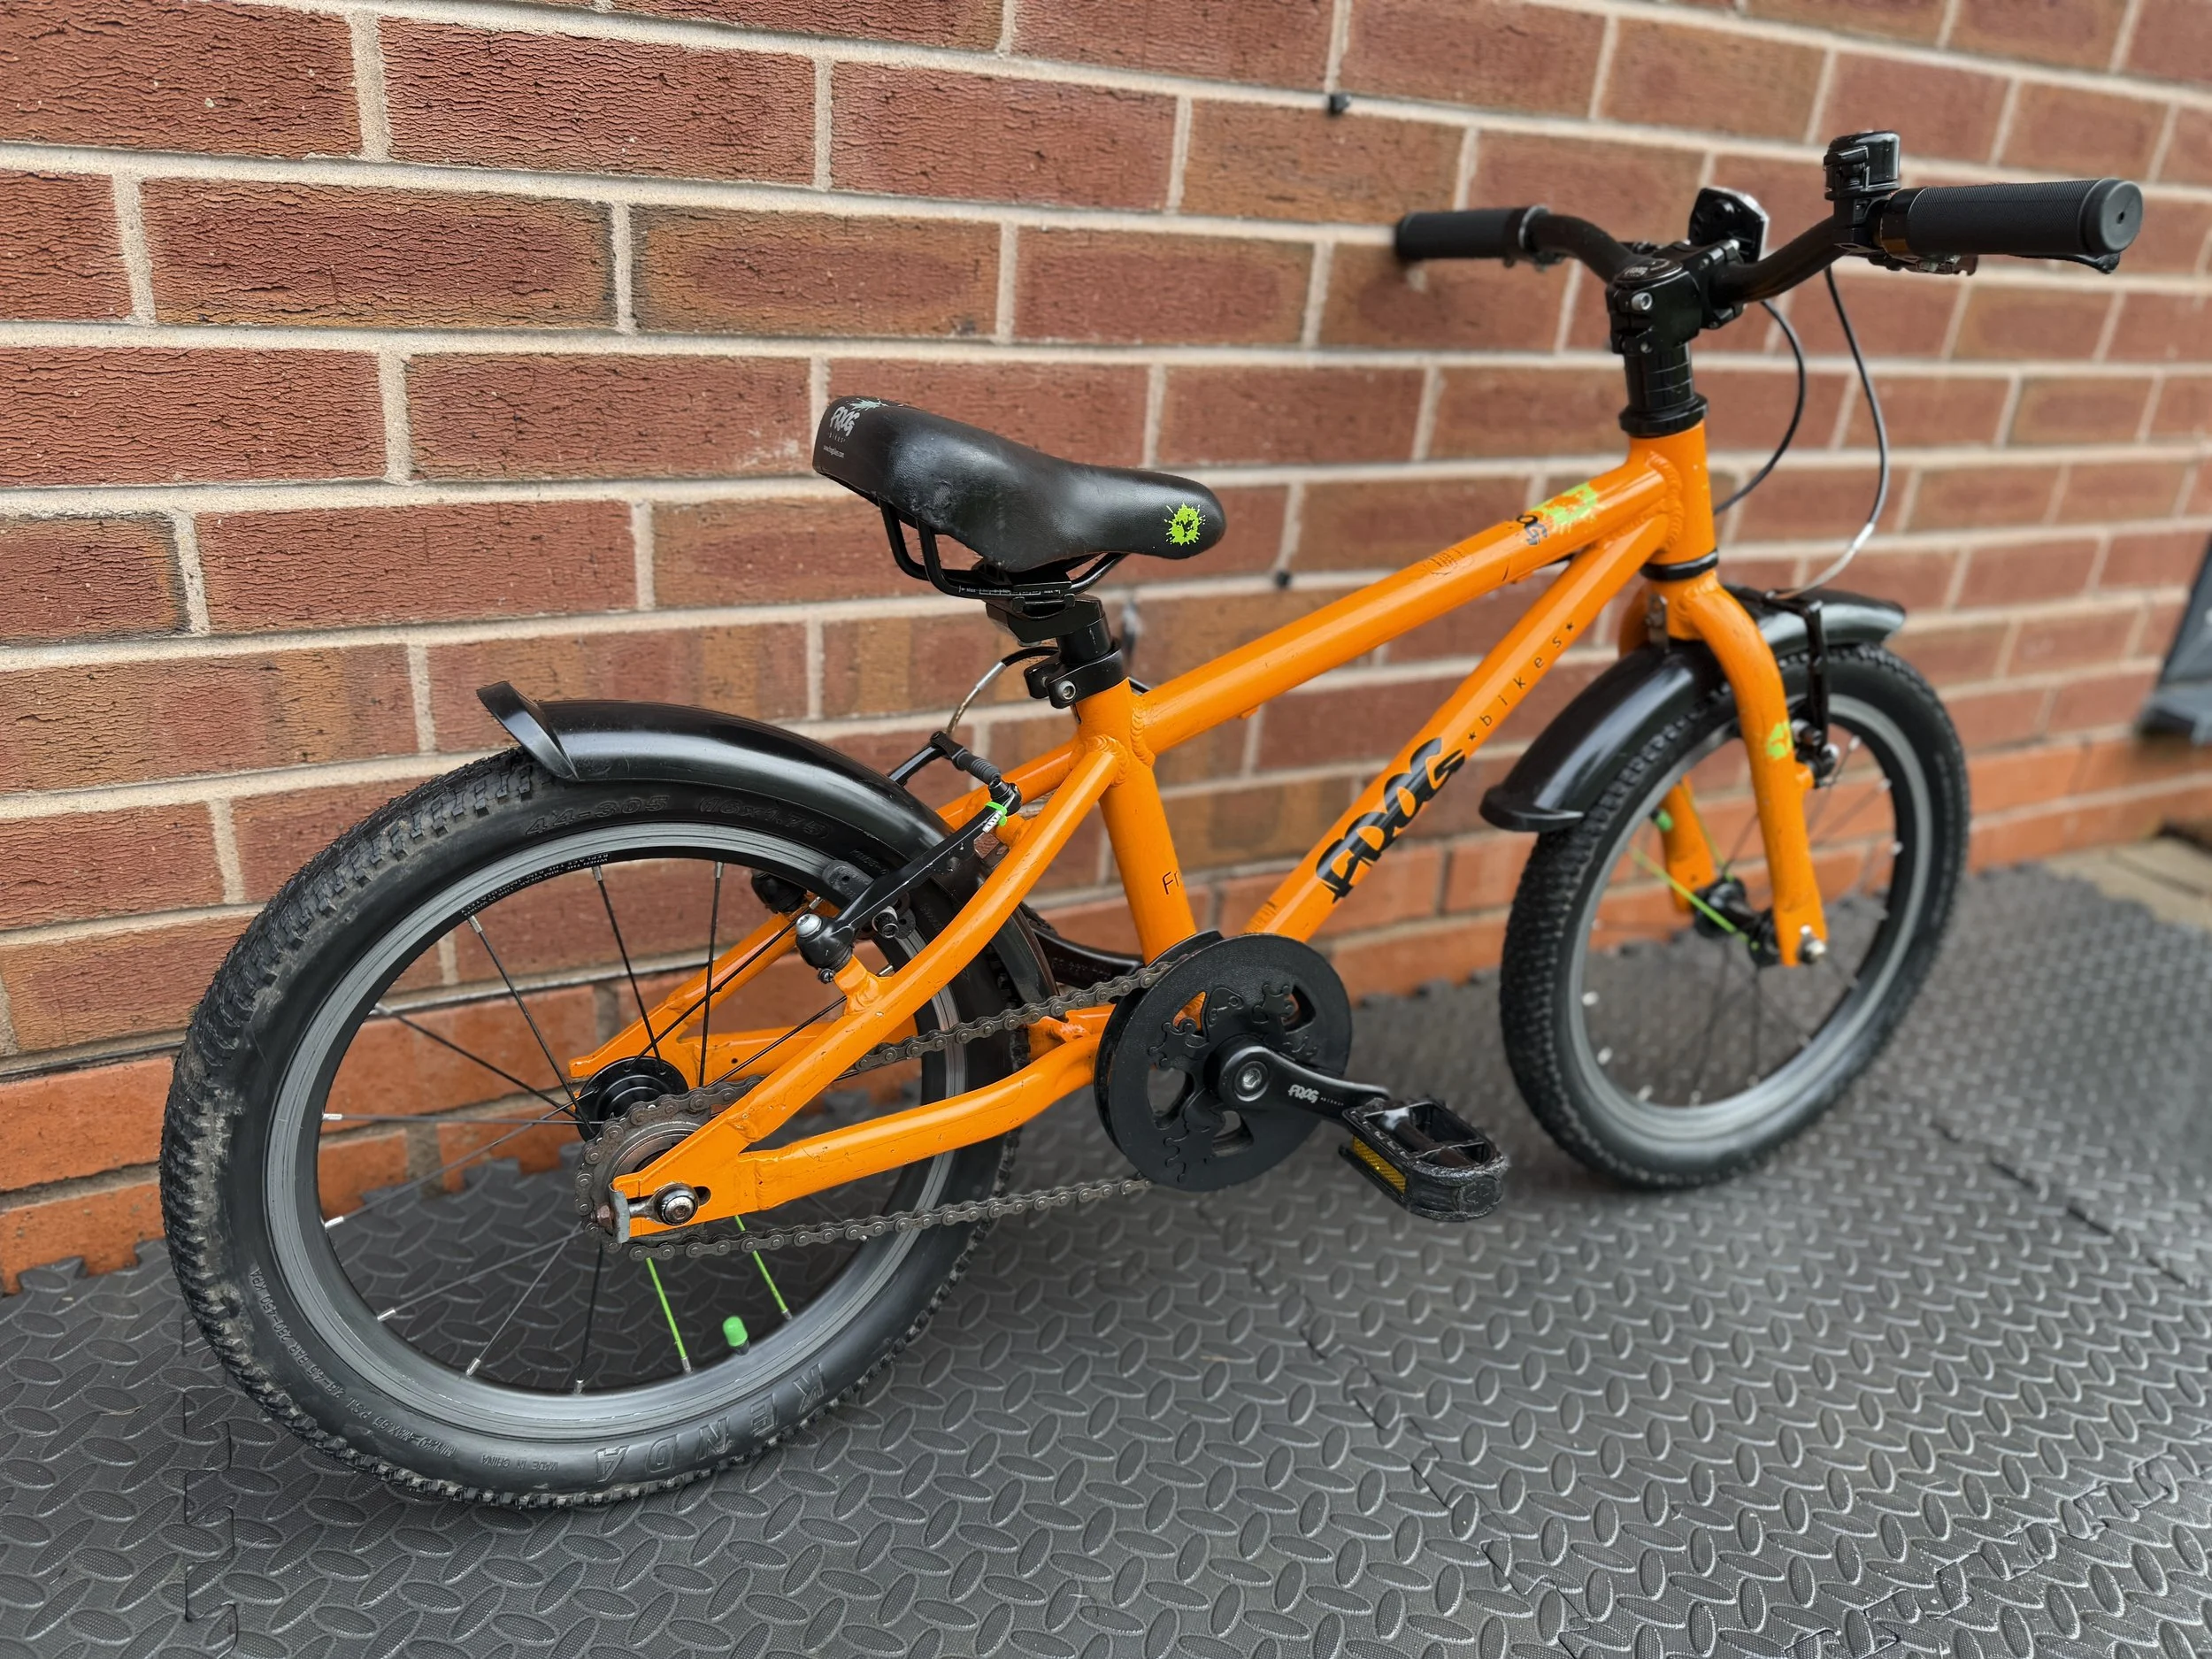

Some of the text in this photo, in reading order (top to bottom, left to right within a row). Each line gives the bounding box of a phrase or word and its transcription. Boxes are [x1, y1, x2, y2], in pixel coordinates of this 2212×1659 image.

[829, 406, 860, 436] FROG
[525, 795, 671, 836] 44-305
[1315, 737, 1466, 904] FROG
[1287, 1084, 1320, 1103] FROG
[250, 1268, 267, 1292] KPA
[260, 1296, 293, 1342] 280-450
[288, 1343, 311, 1364] BAR
[595, 1363, 827, 1483] KENDA
[481, 1455, 559, 1471] MADE IN CHINA
